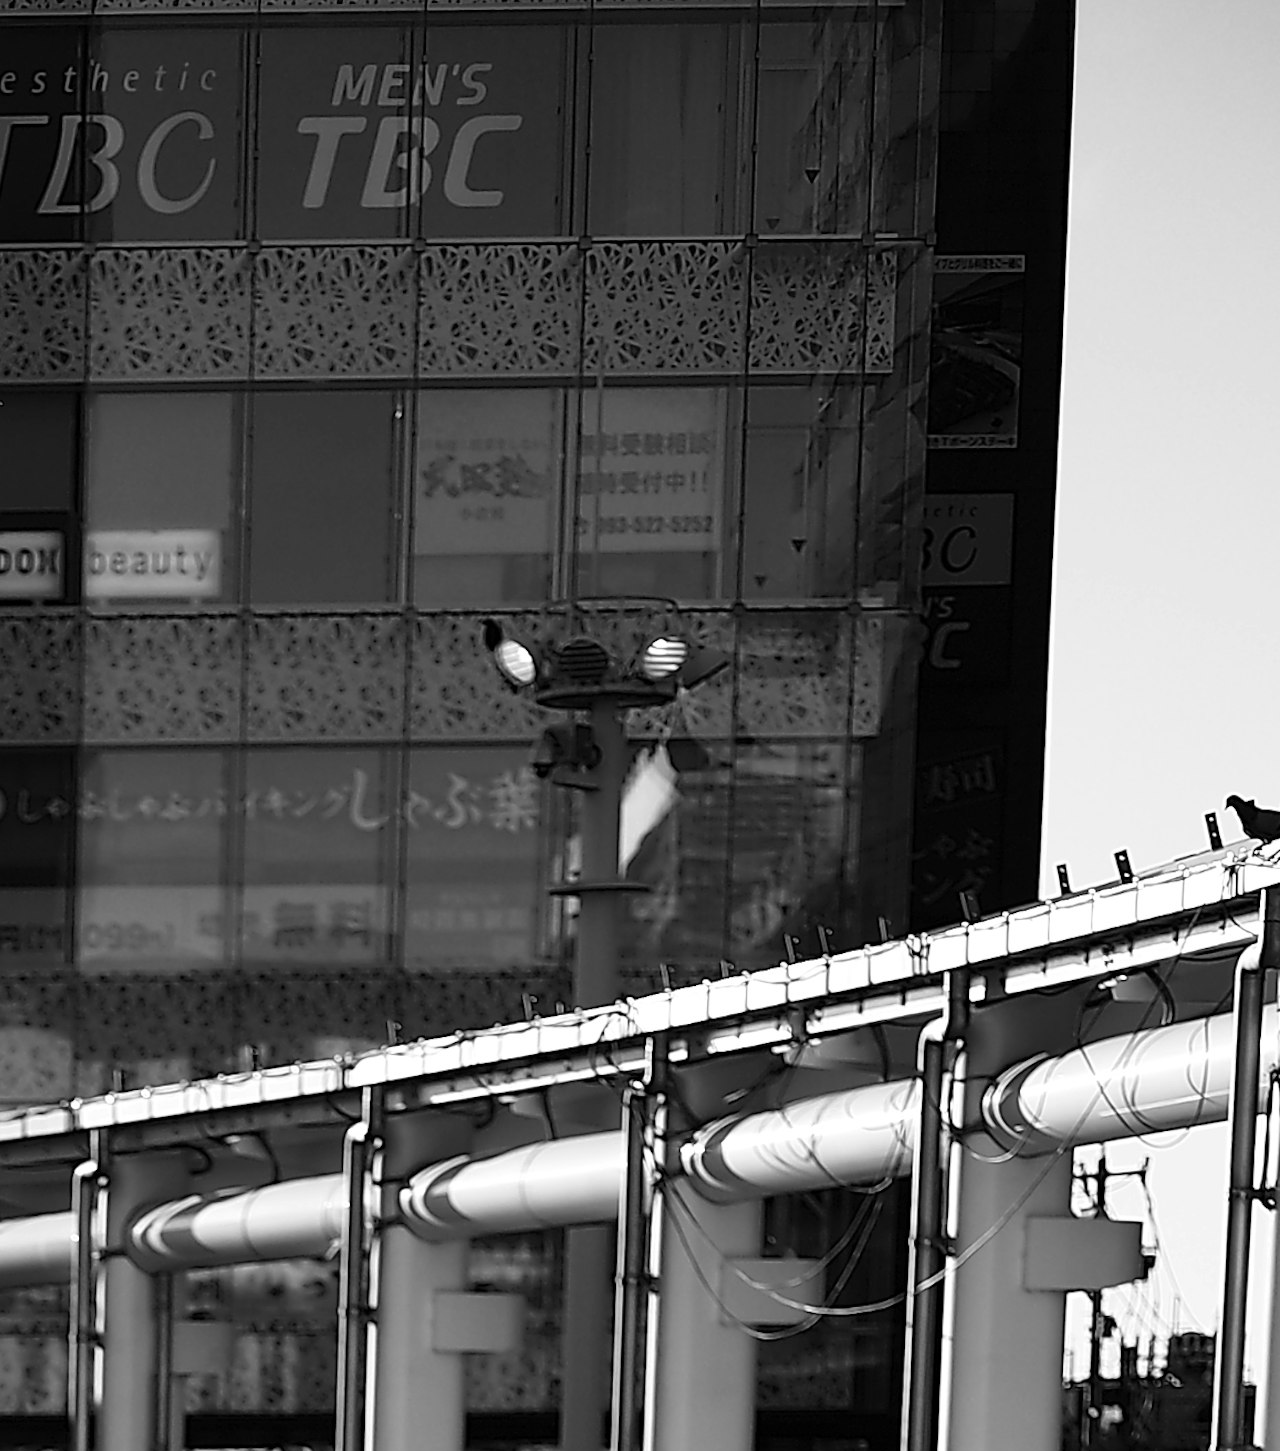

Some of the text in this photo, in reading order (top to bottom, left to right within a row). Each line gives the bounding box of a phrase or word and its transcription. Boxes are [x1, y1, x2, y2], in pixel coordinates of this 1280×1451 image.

[329, 62, 493, 107] MEN'S
[296, 114, 524, 209] TBC
[88, 545, 214, 581] beauty
